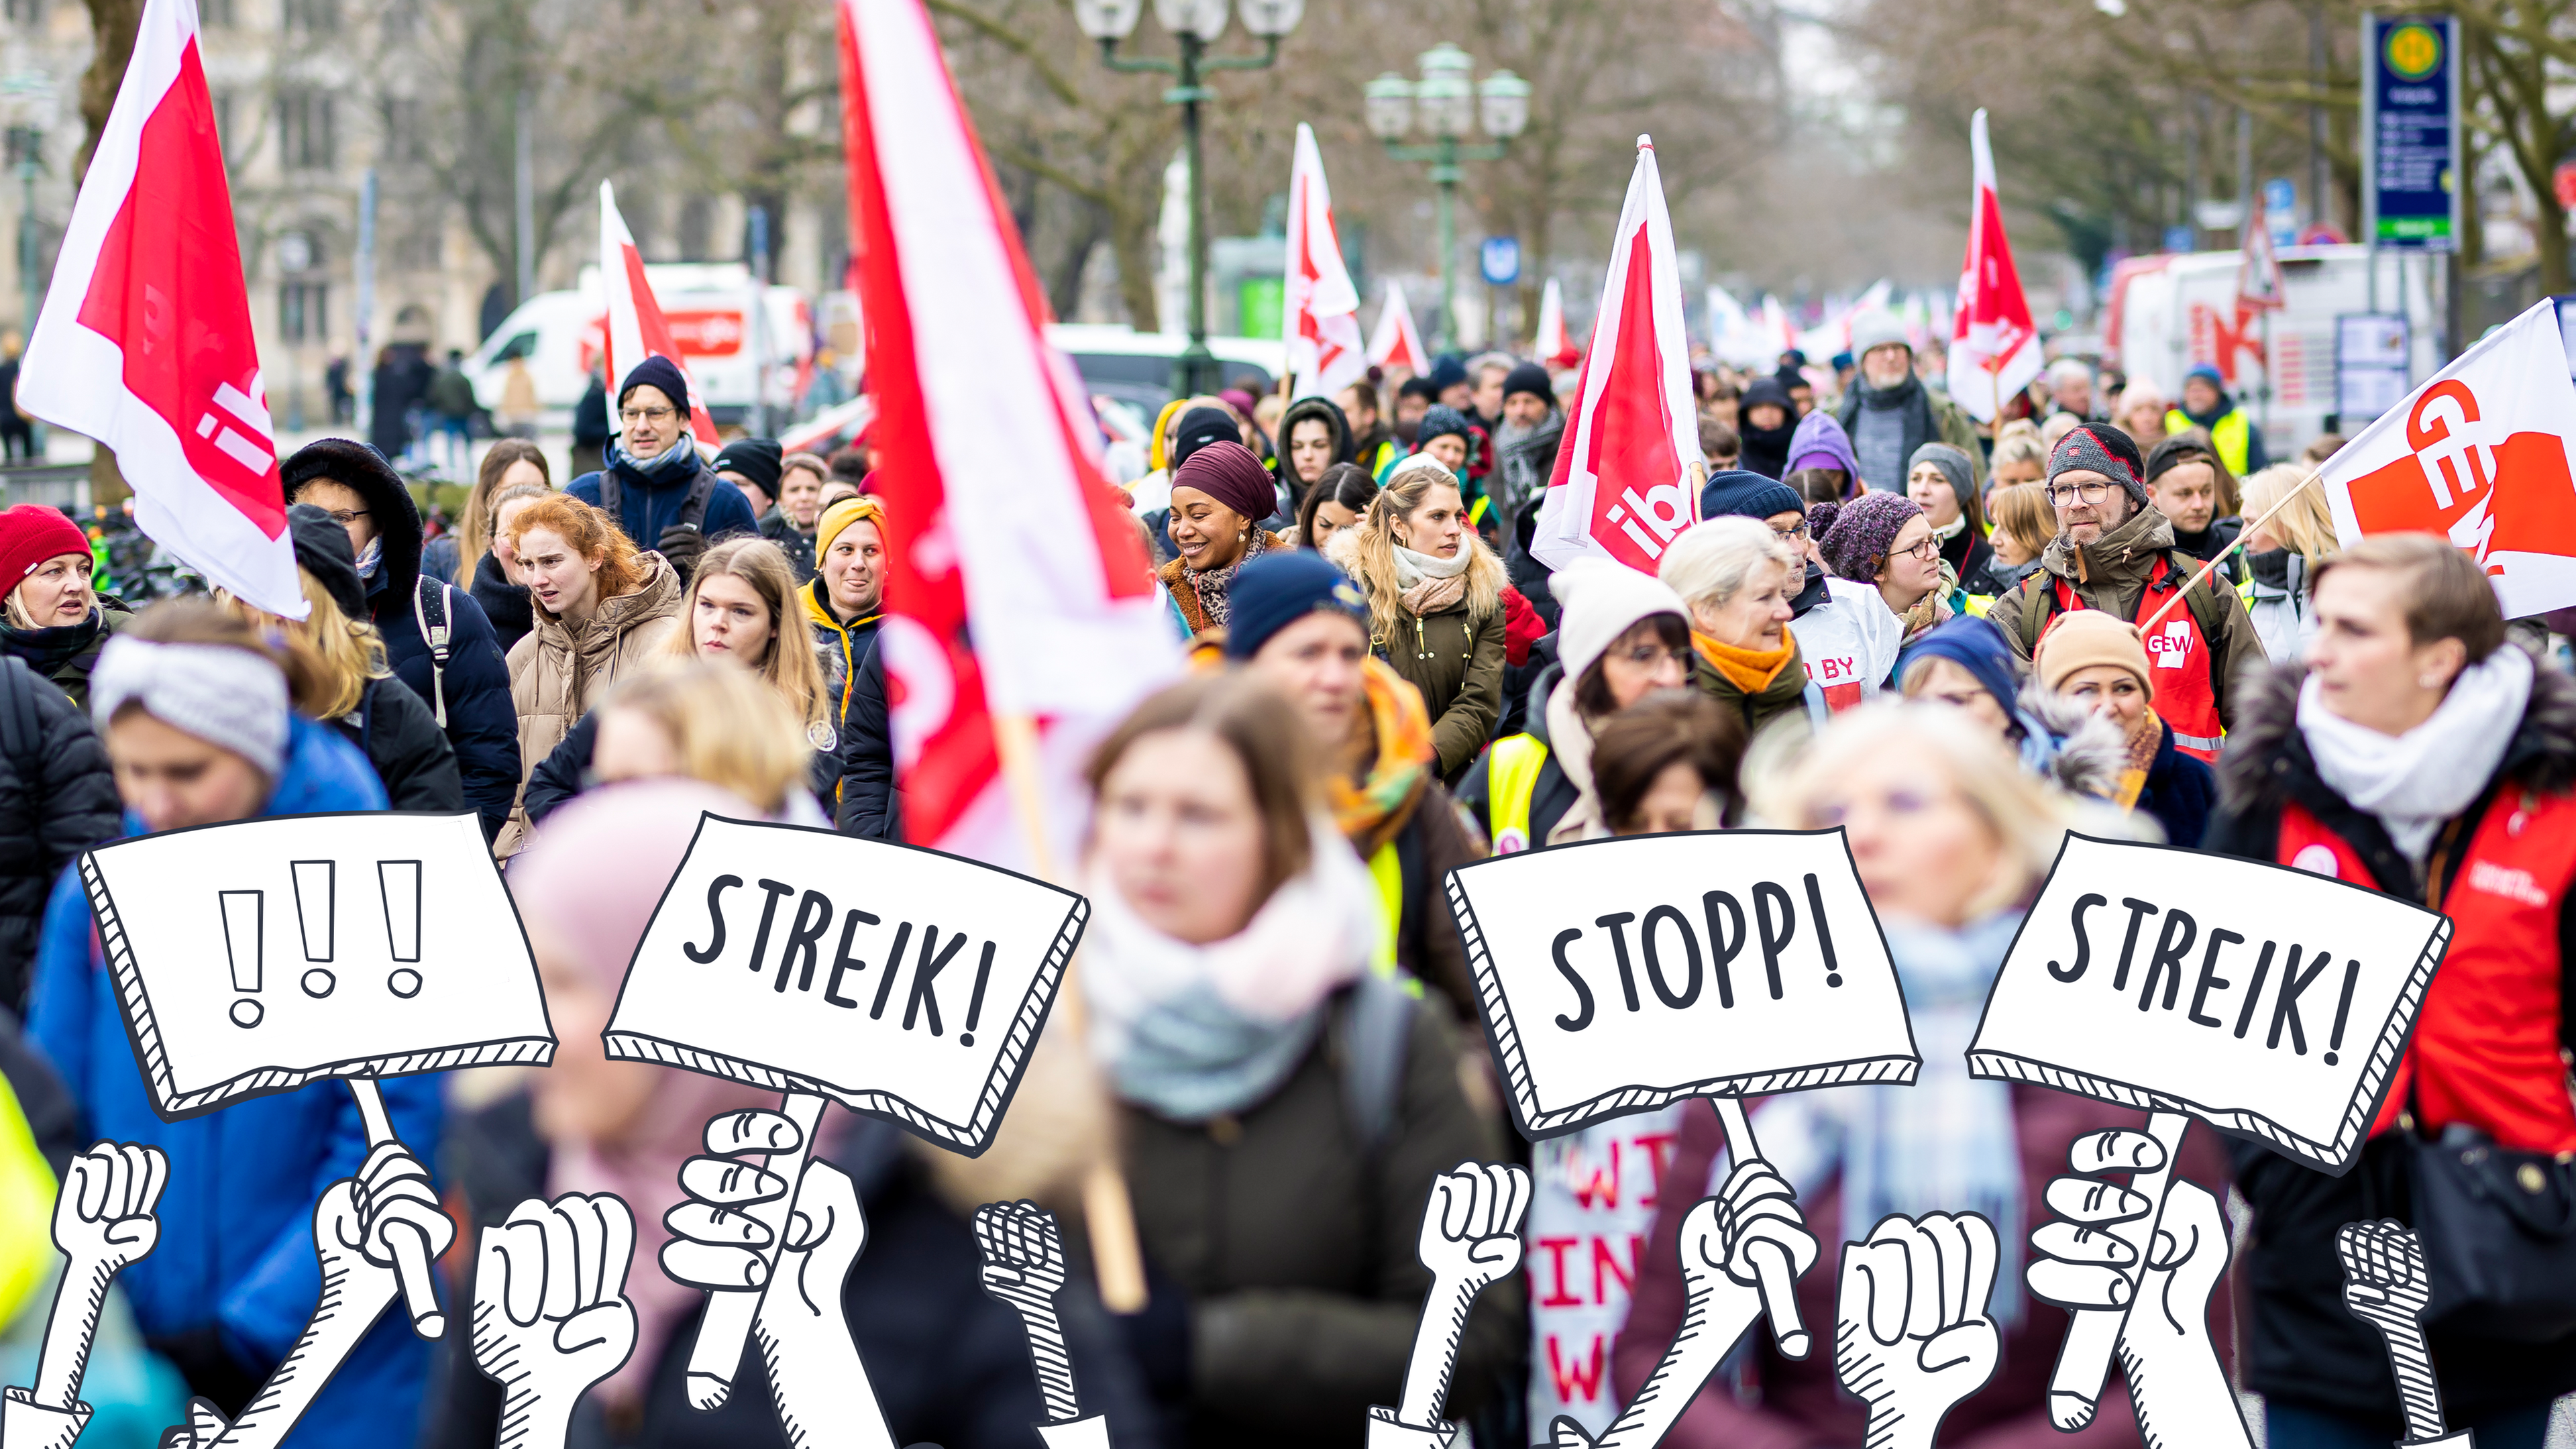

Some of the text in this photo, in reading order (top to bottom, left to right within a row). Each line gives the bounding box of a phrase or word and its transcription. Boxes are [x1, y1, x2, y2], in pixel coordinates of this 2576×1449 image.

[1484, 239, 1517, 280] U
[2147, 635, 2194, 654] GEW
[1821, 656, 1854, 680] BY
